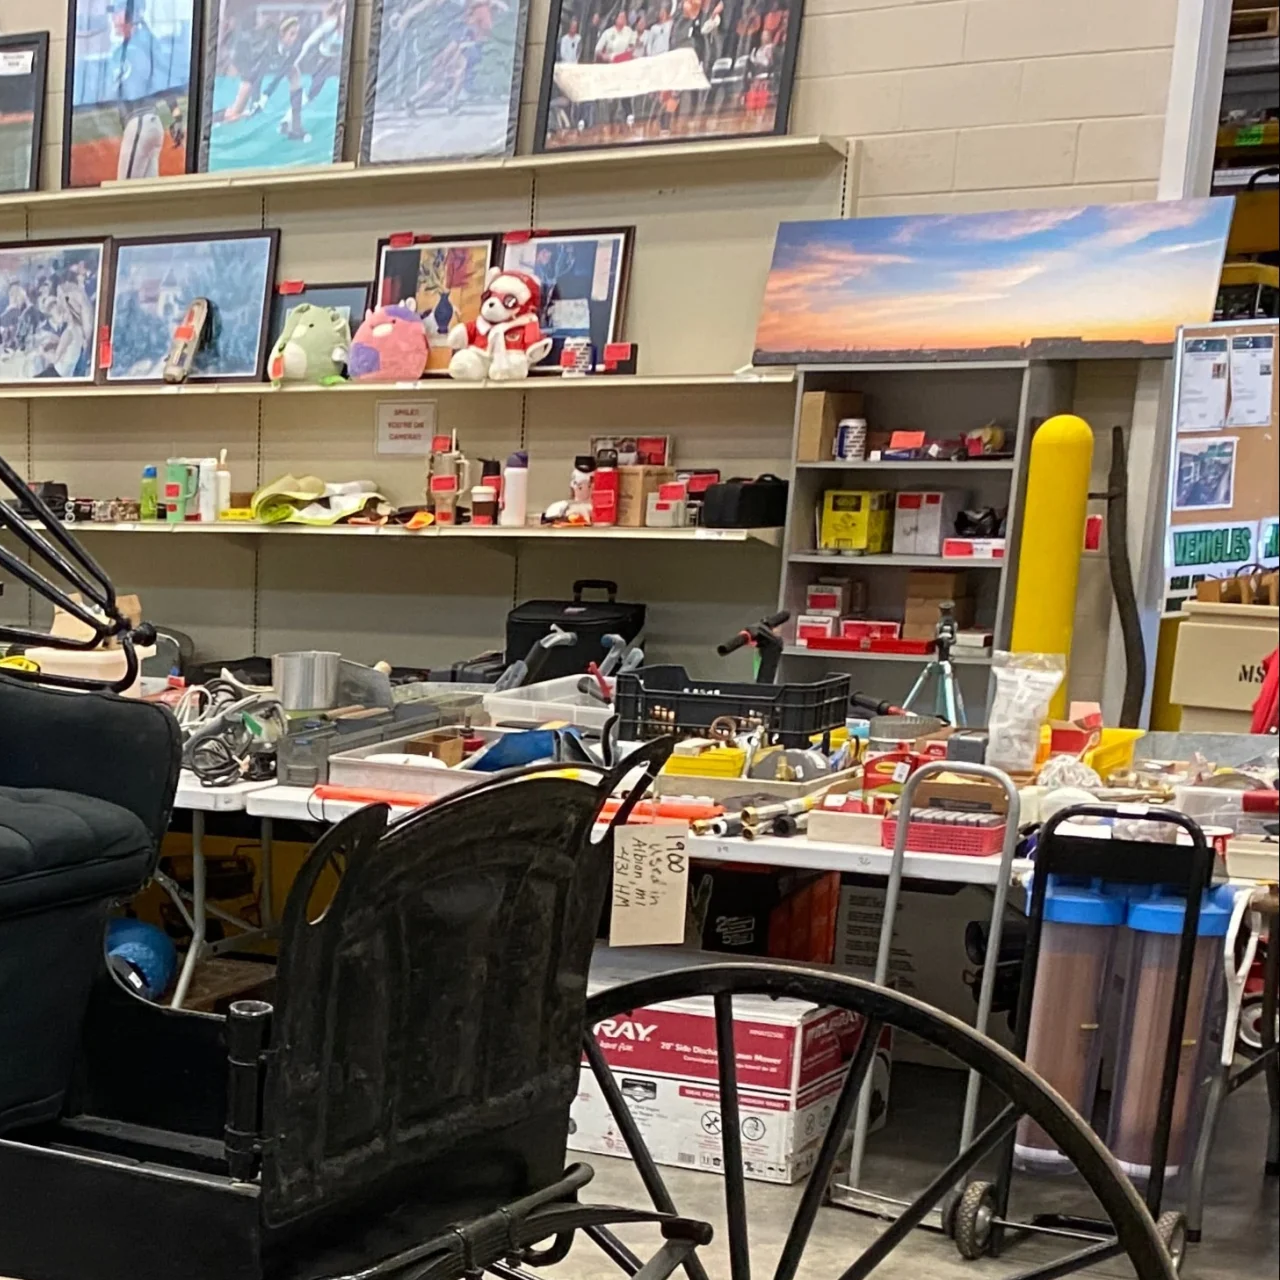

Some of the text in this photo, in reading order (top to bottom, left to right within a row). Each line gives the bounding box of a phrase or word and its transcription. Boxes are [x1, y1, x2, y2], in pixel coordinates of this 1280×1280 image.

[1173, 527, 1252, 567] VEHICLES
[665, 835, 685, 873] 1900
[649, 890, 666, 906] in
